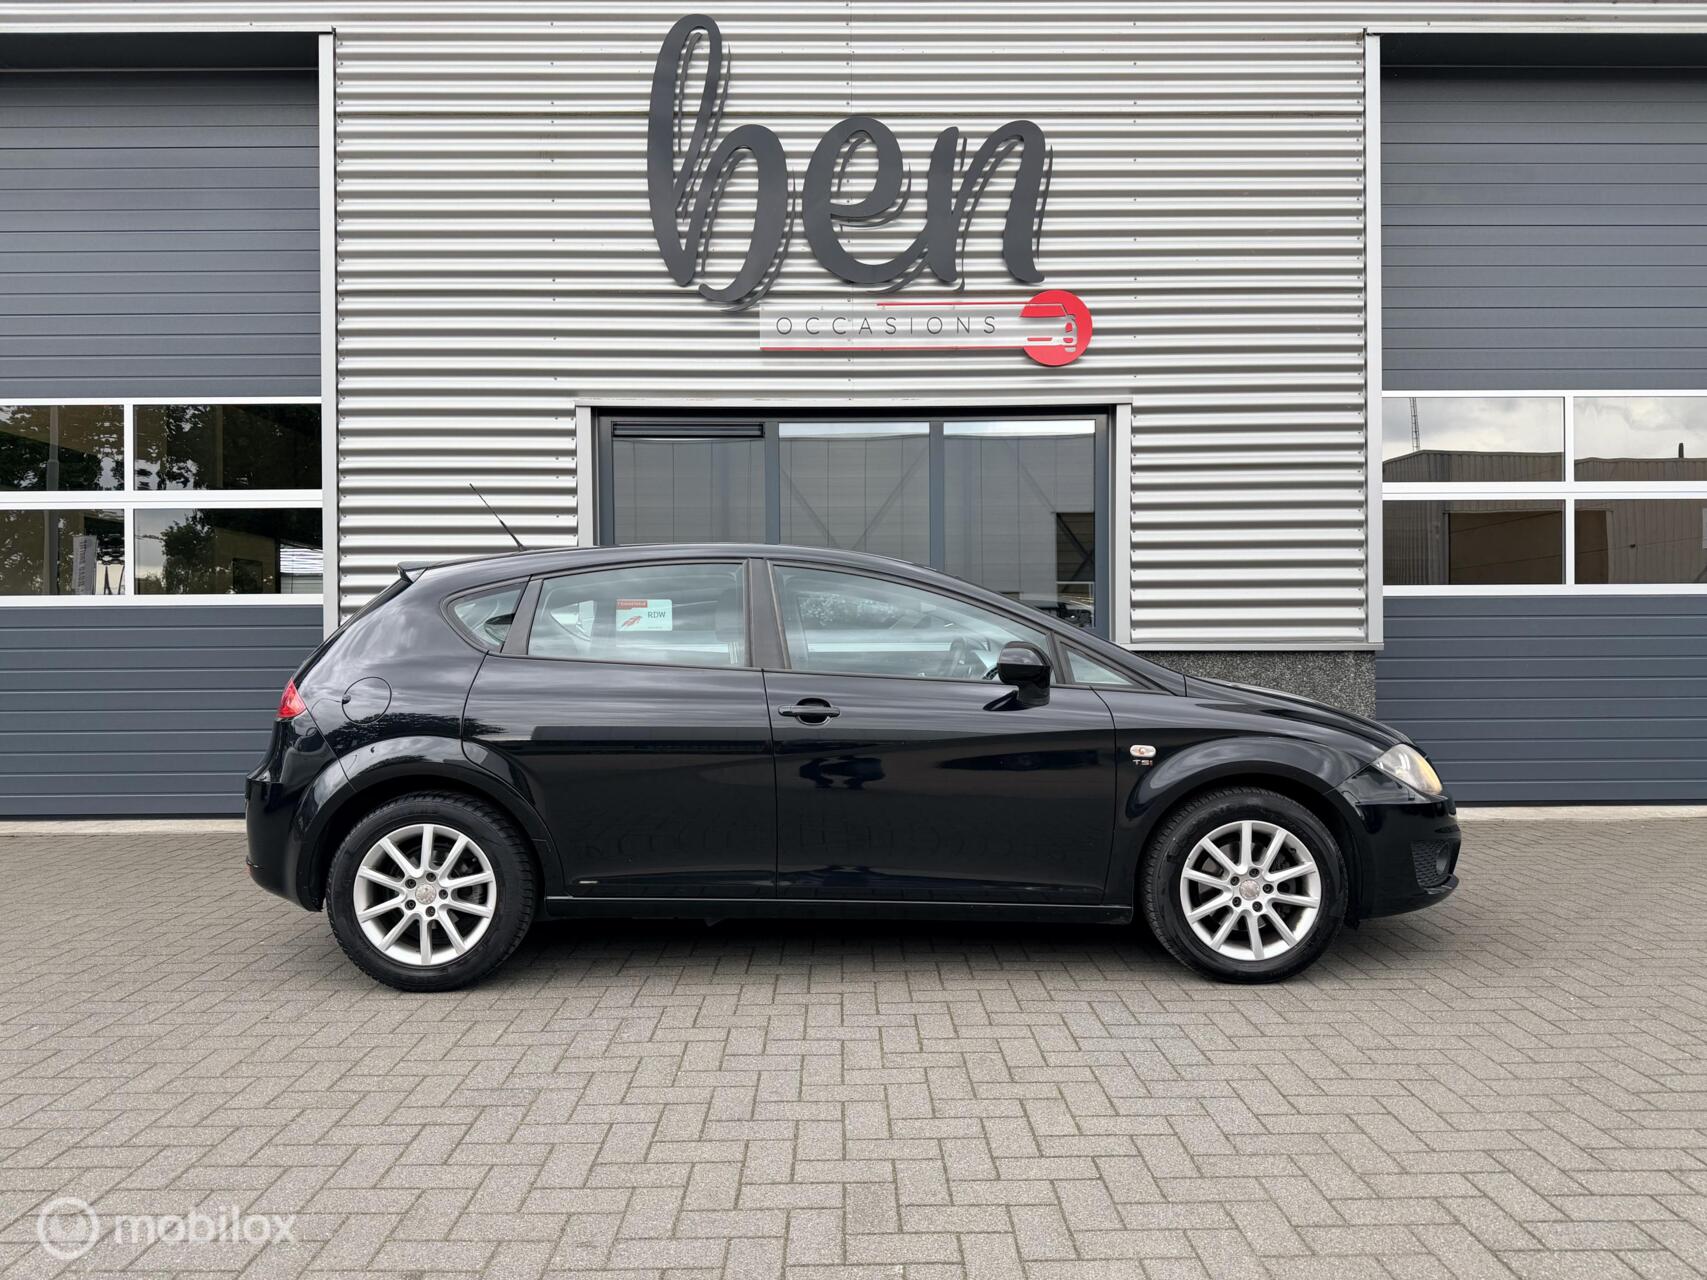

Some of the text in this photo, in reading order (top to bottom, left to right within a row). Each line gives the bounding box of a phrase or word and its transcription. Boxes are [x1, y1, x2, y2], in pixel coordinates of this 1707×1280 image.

[647, 14, 1051, 303] ben
[776, 315, 997, 336] OCCASIONS
[647, 611, 666, 619] RDW
